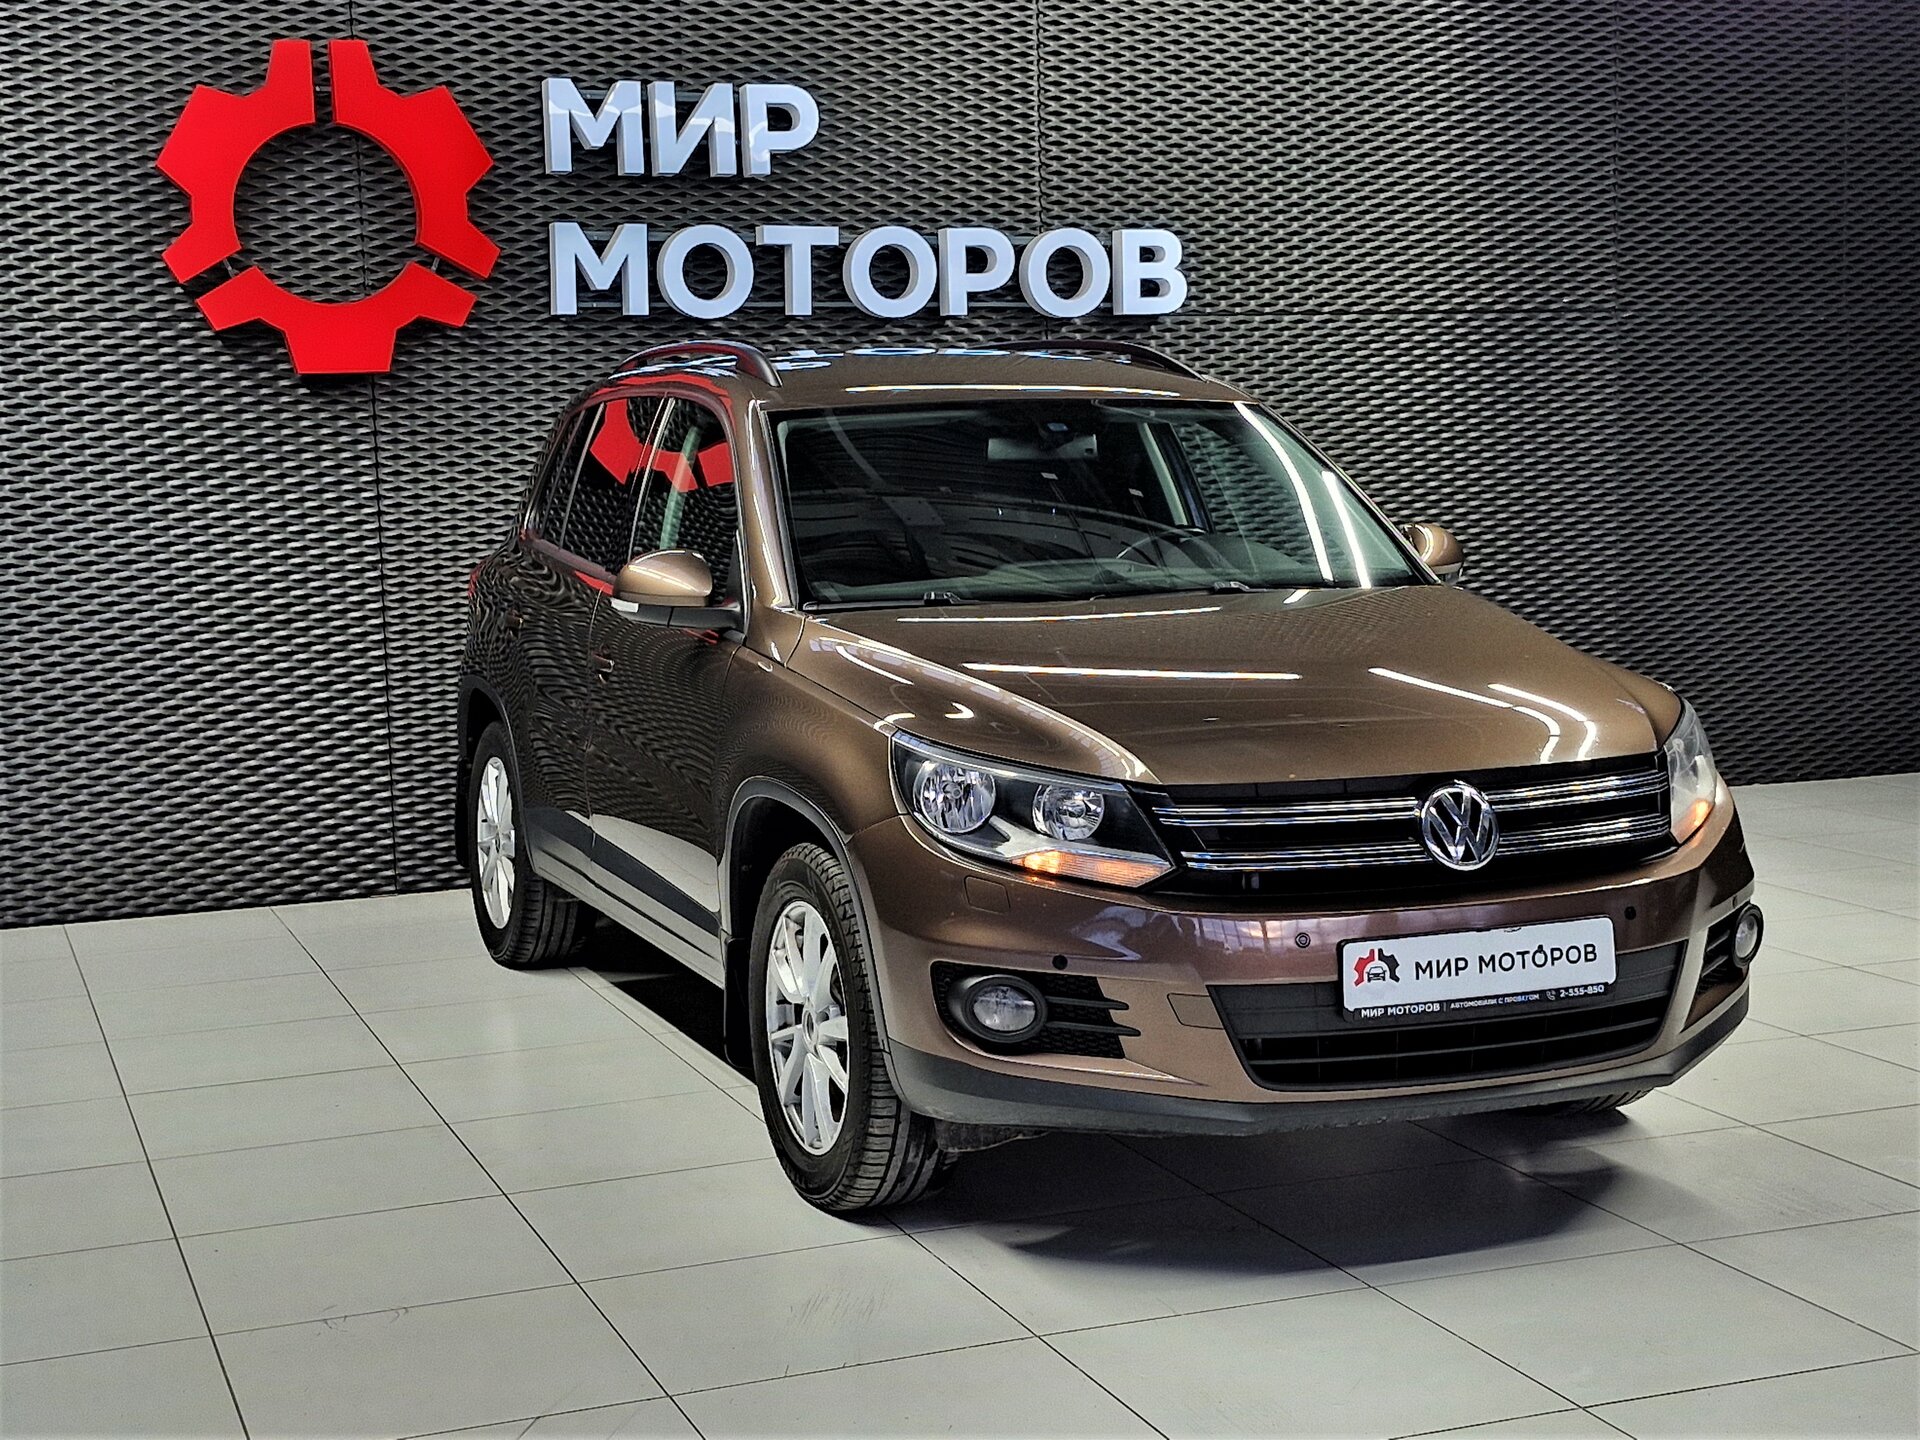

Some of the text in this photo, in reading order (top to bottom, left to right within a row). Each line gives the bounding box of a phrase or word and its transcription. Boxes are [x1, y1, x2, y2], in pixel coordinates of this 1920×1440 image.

[542, 77, 820, 178] МИР
[548, 221, 1188, 319] МОТОРОВ
[1414, 943, 1598, 981] МИР МОТОРОВ
[1360, 1002, 1441, 1018] МИР МОТОРОВ
[1559, 985, 1605, 998] 2-555-850
